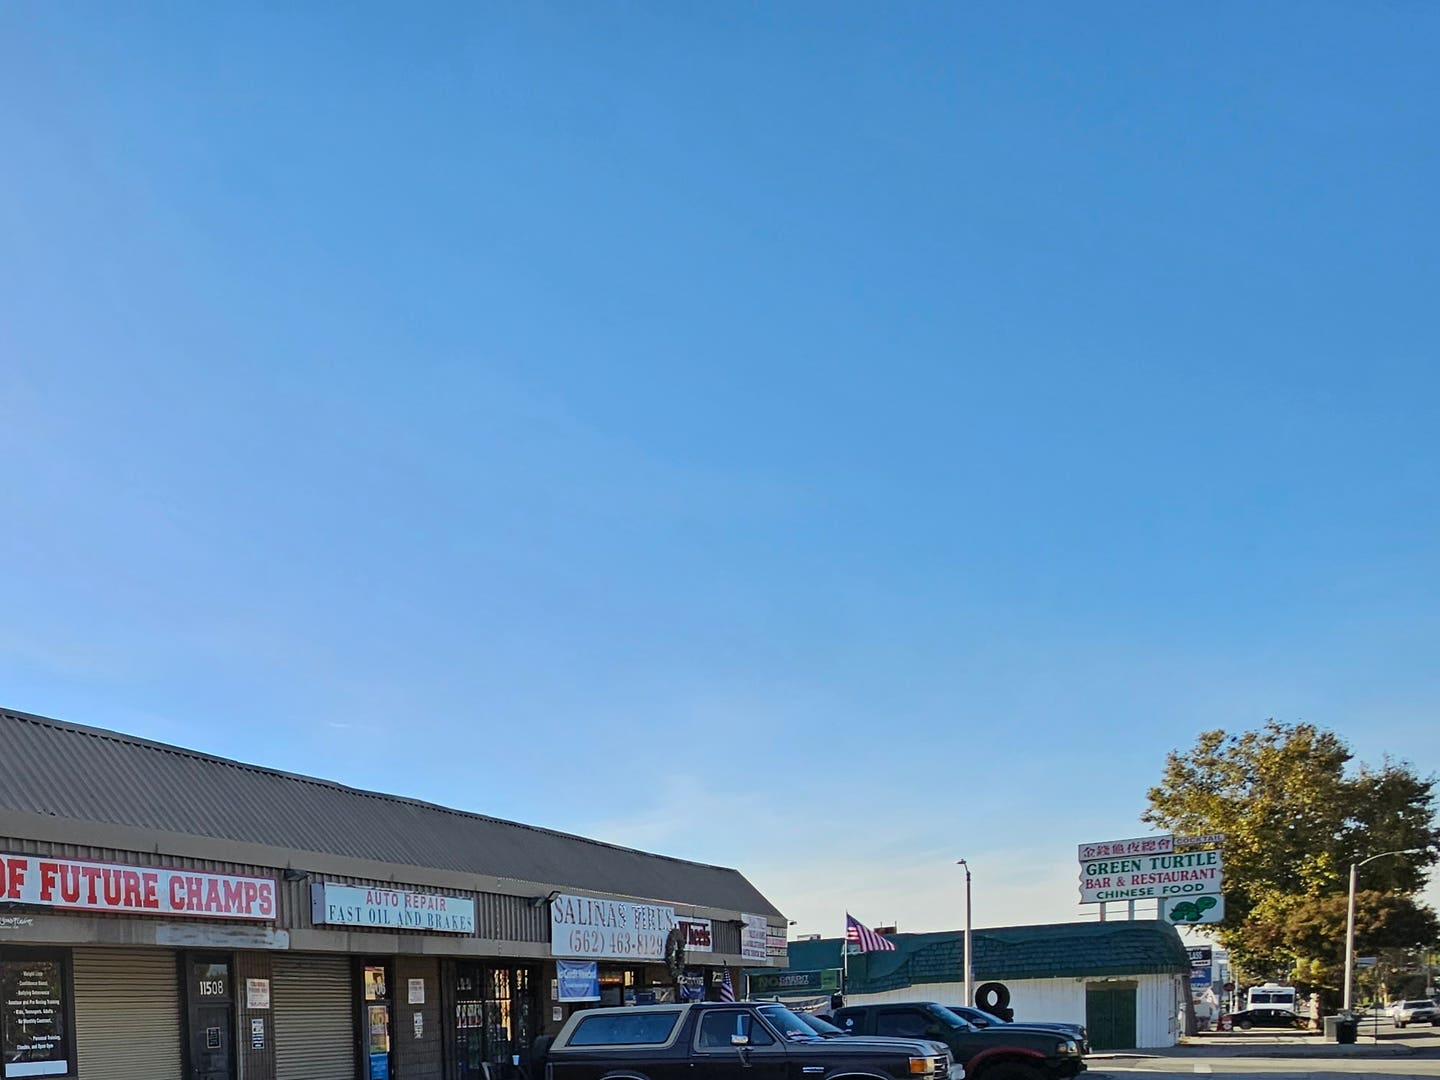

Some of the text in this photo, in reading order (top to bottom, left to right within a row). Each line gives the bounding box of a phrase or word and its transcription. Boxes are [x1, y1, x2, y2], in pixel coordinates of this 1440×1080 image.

[1176, 835, 1222, 844] COCKTAIL
[1086, 851, 1217, 876] GREEN TURTLE
[38, 861, 160, 910] FUTURE
[168, 874, 273, 915] CHAMPS
[1085, 868, 1216, 889] BAR & RESTAURANT
[366, 891, 447, 911] AUTO REPAIR
[1096, 883, 1204, 900] CHINESE FOOD
[329, 904, 472, 931] FAST OIL AND BRAKES
[554, 897, 627, 928] SALINAS
[569, 930, 605, 953] (562)
[199, 980, 224, 995] 11508
